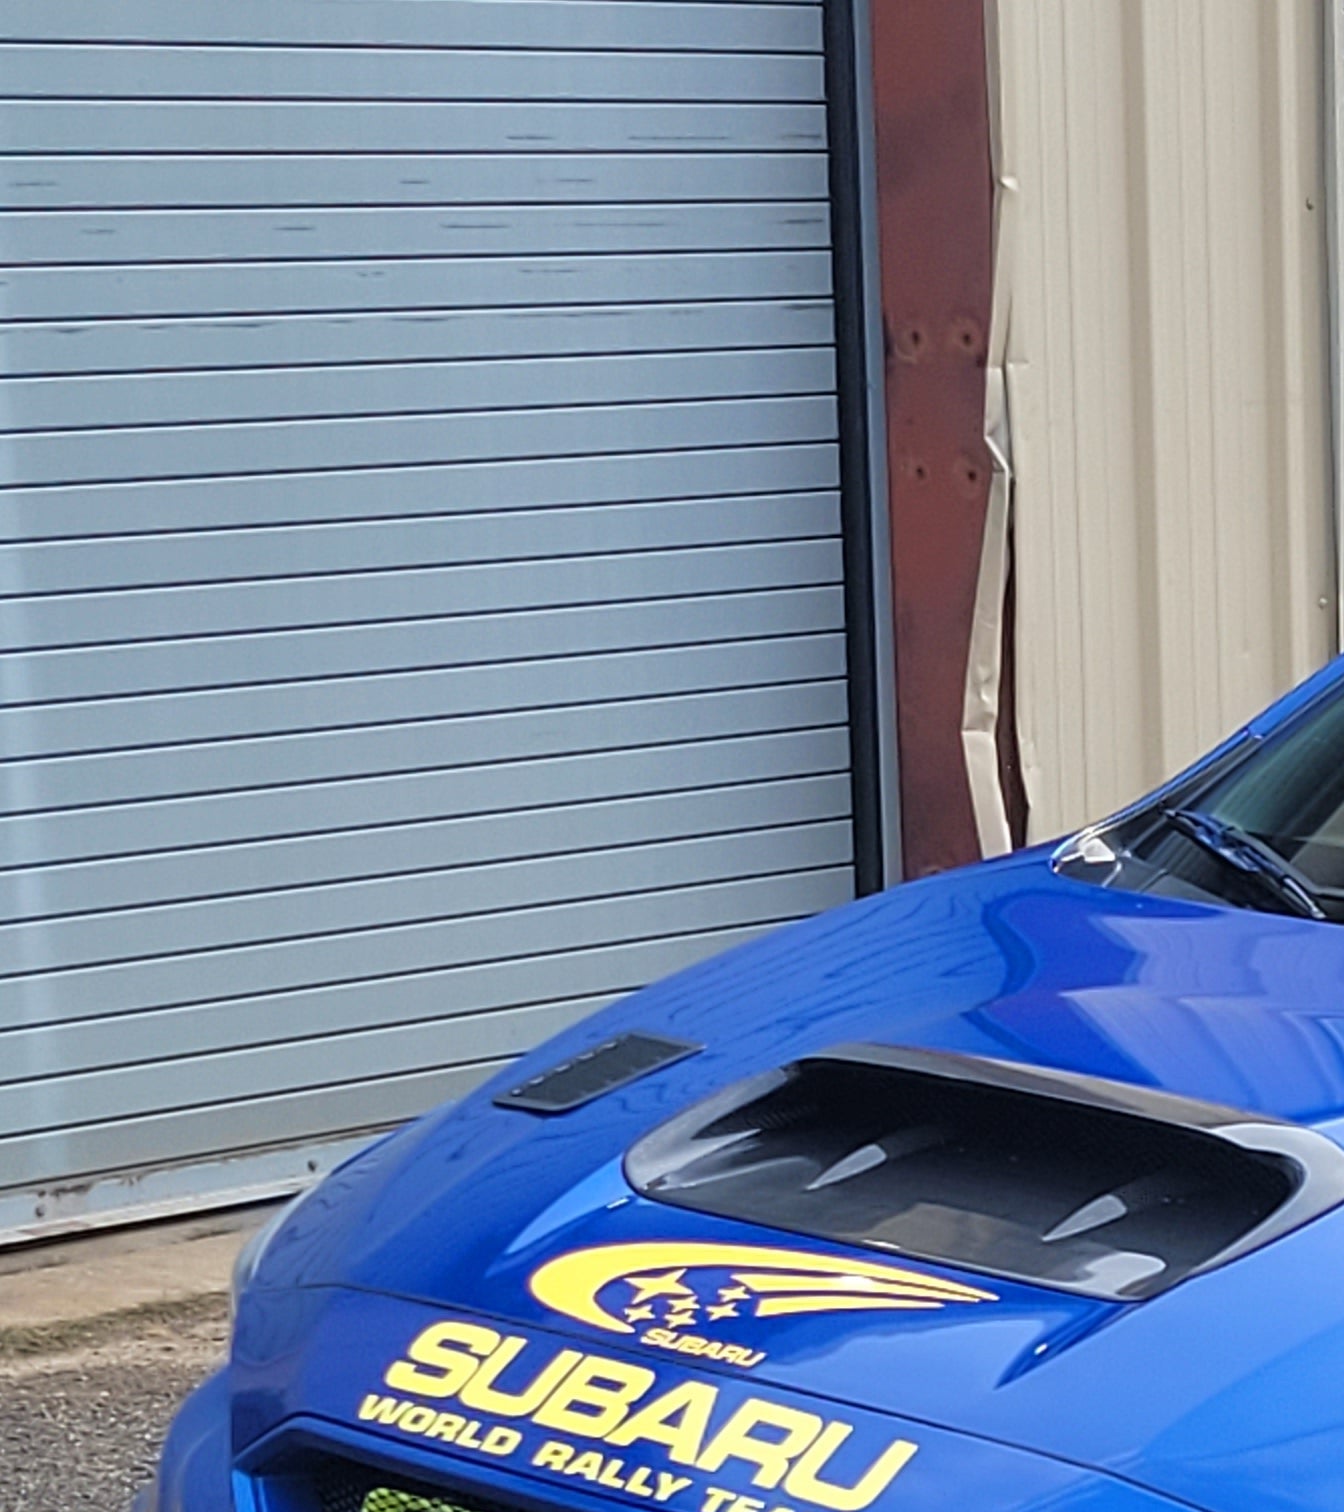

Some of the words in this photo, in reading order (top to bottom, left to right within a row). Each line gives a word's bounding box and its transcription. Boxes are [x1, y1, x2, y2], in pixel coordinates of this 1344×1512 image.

[640, 1327, 766, 1368] SUBARU
[358, 1394, 522, 1457] WORLD
[532, 1441, 693, 1502] RALLY
[384, 1320, 919, 1512] SUBARU
